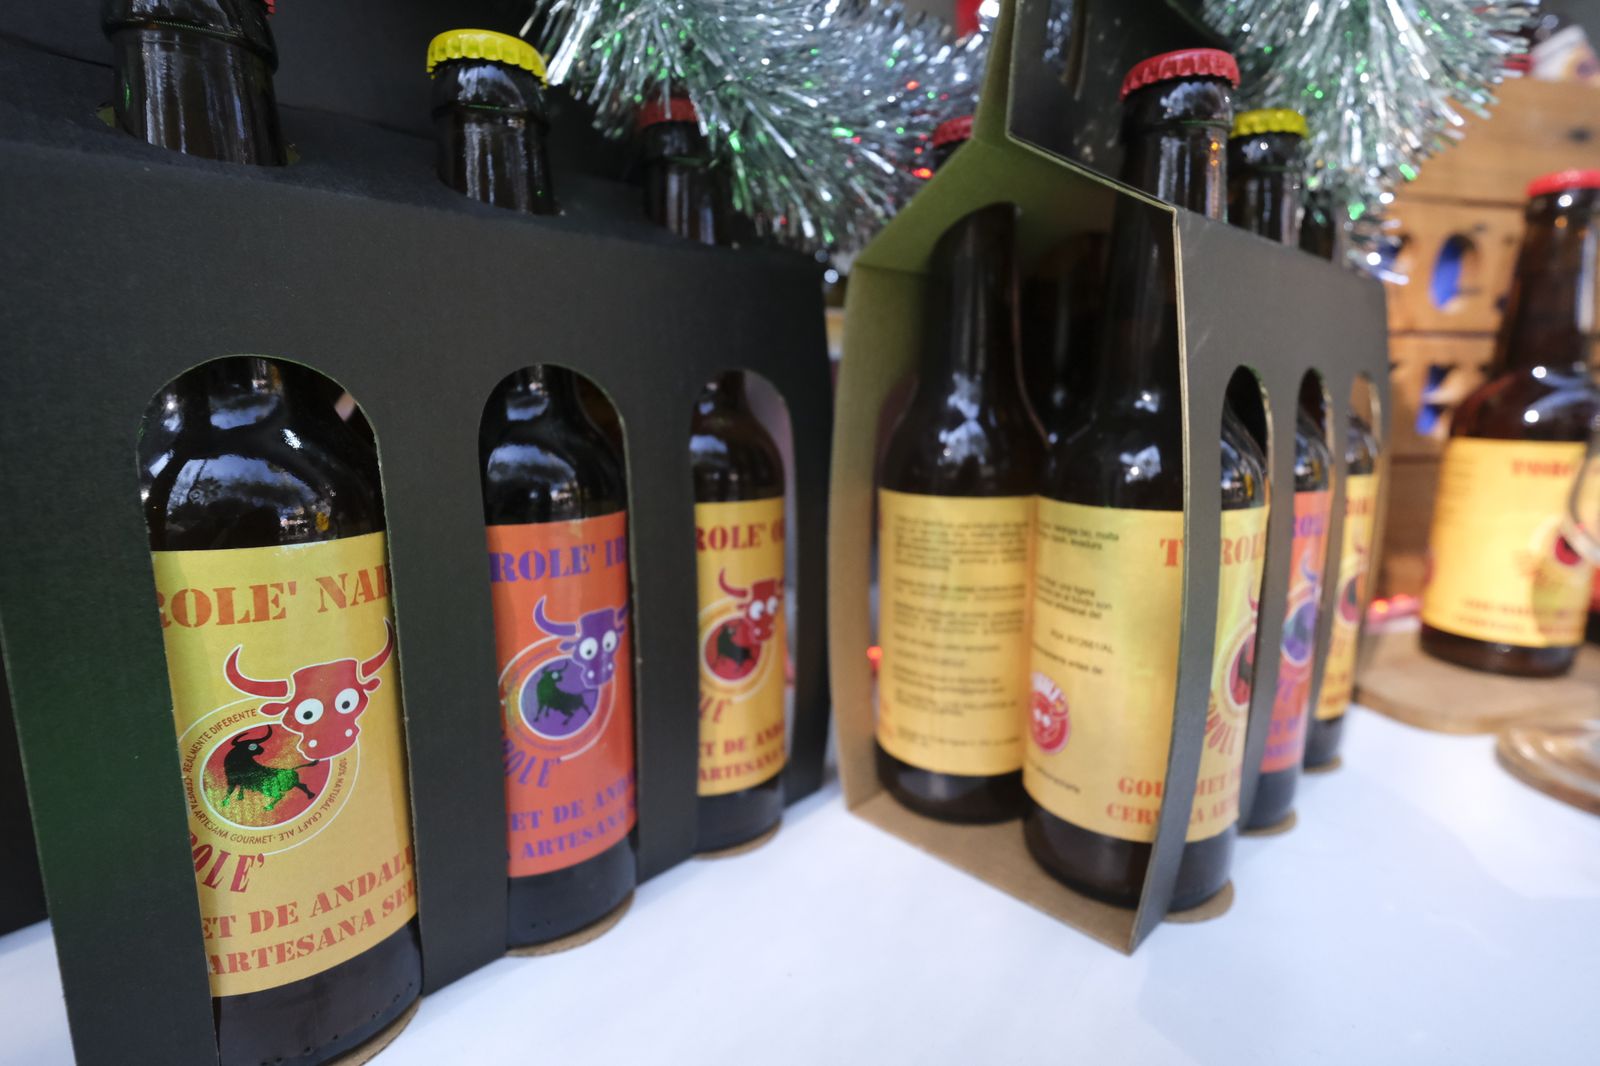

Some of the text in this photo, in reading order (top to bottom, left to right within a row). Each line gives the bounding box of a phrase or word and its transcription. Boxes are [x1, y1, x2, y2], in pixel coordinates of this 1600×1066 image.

[183, 708, 257, 773] REALMENTE DIFERENTE
[320, 777, 345, 811] NATURAL
[194, 810, 229, 839] ARTESANA
[230, 833, 273, 845] GOURMET
[279, 828, 295, 841] ALE
[298, 811, 322, 833] CRAFT
[248, 902, 299, 935] DE
[208, 906, 377, 976] ARTESANA
